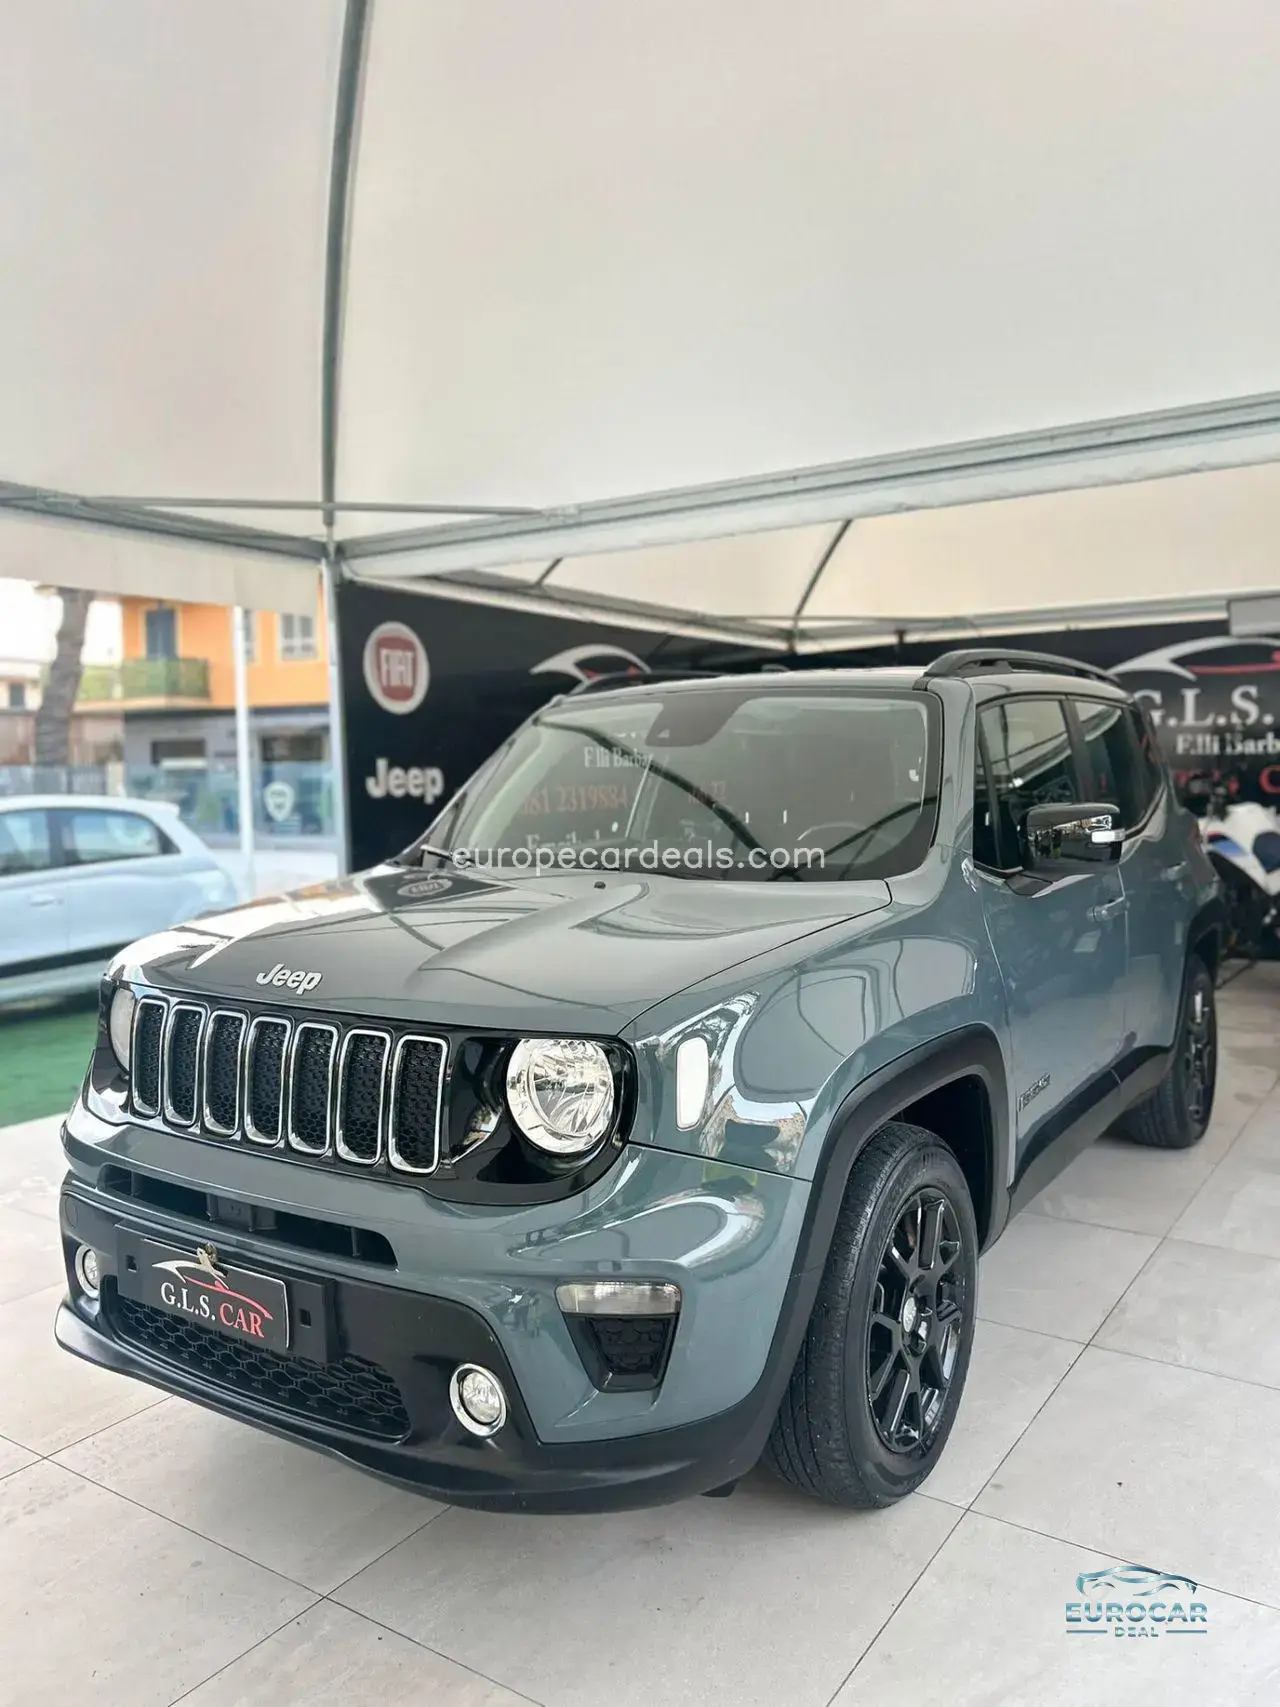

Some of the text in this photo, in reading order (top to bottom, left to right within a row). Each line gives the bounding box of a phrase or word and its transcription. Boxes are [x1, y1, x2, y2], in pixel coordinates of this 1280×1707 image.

[365, 757, 444, 804] Jeep
[256, 963, 322, 995] Jeep
[160, 1282, 265, 1338] G.L.S. CAR
